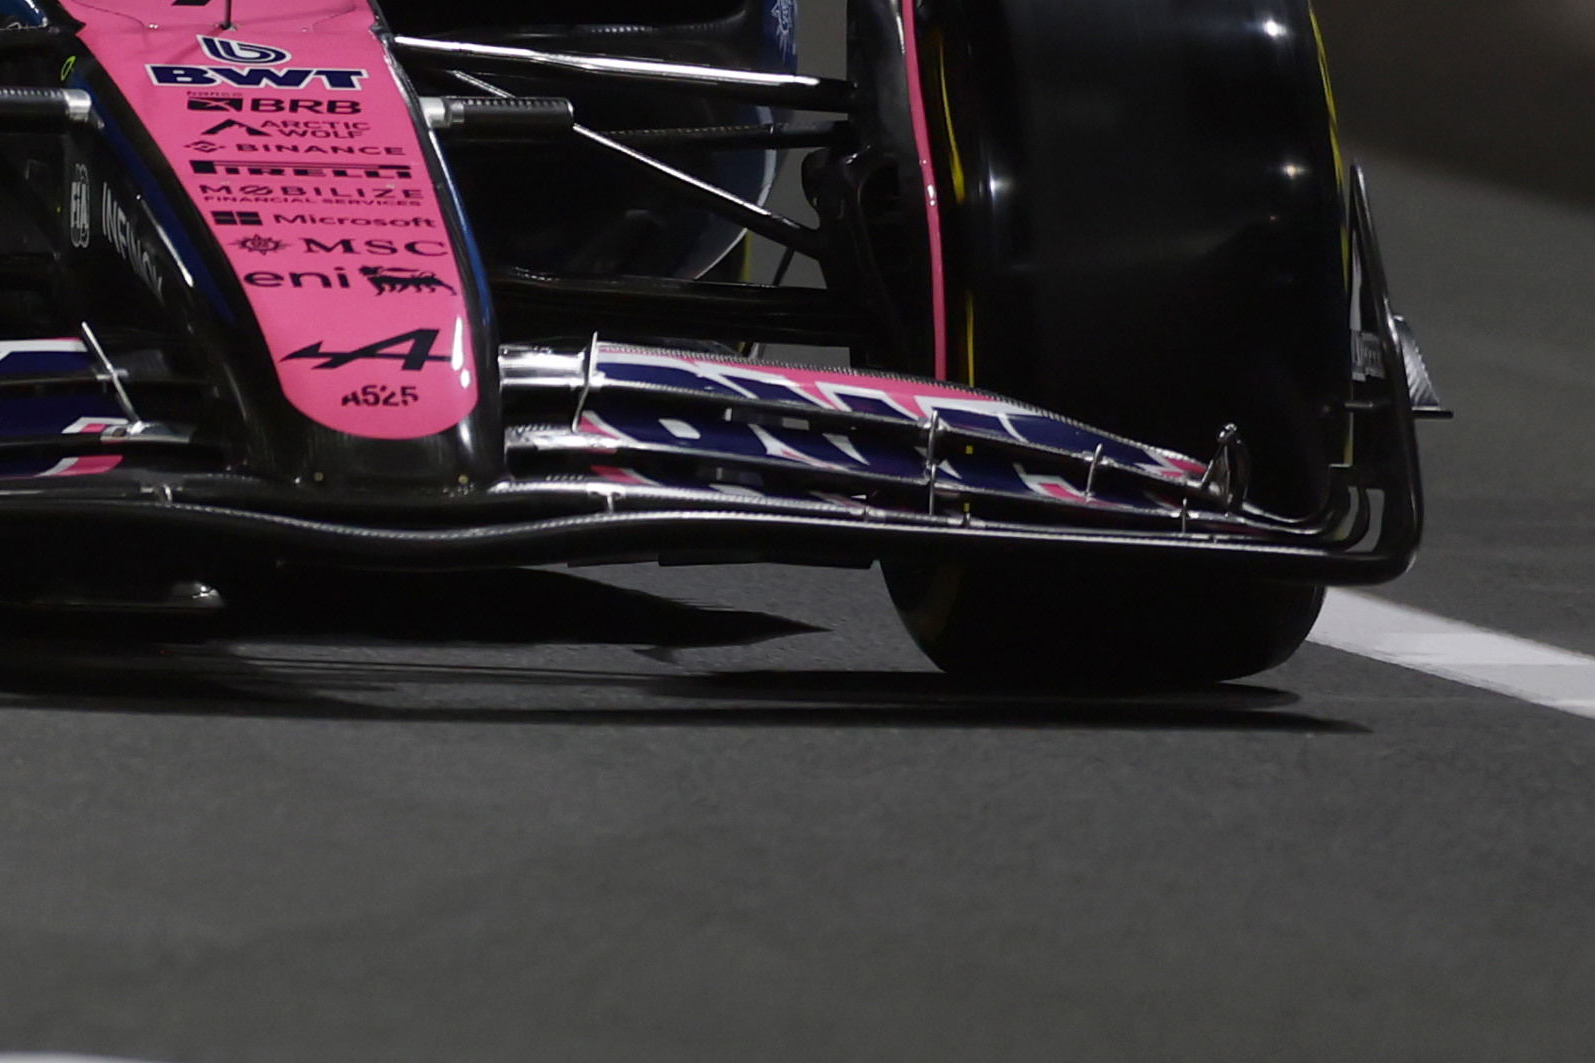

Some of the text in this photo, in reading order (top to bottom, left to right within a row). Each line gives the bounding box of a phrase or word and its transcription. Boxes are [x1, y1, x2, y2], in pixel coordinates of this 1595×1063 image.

[145, 63, 370, 90] BWT
[250, 97, 363, 115] BRB
[259, 120, 372, 131] ARCTIC
[277, 129, 363, 139] WOLF
[235, 143, 406, 156] BINANCE
[189, 159, 412, 179] PIRELLI
[201, 195, 423, 206] FINANCIAL SERVICES
[273, 213, 438, 228] Microsoft
[300, 237, 449, 257] MSC
[243, 266, 351, 288] eni
[341, 384, 419, 407] A525
